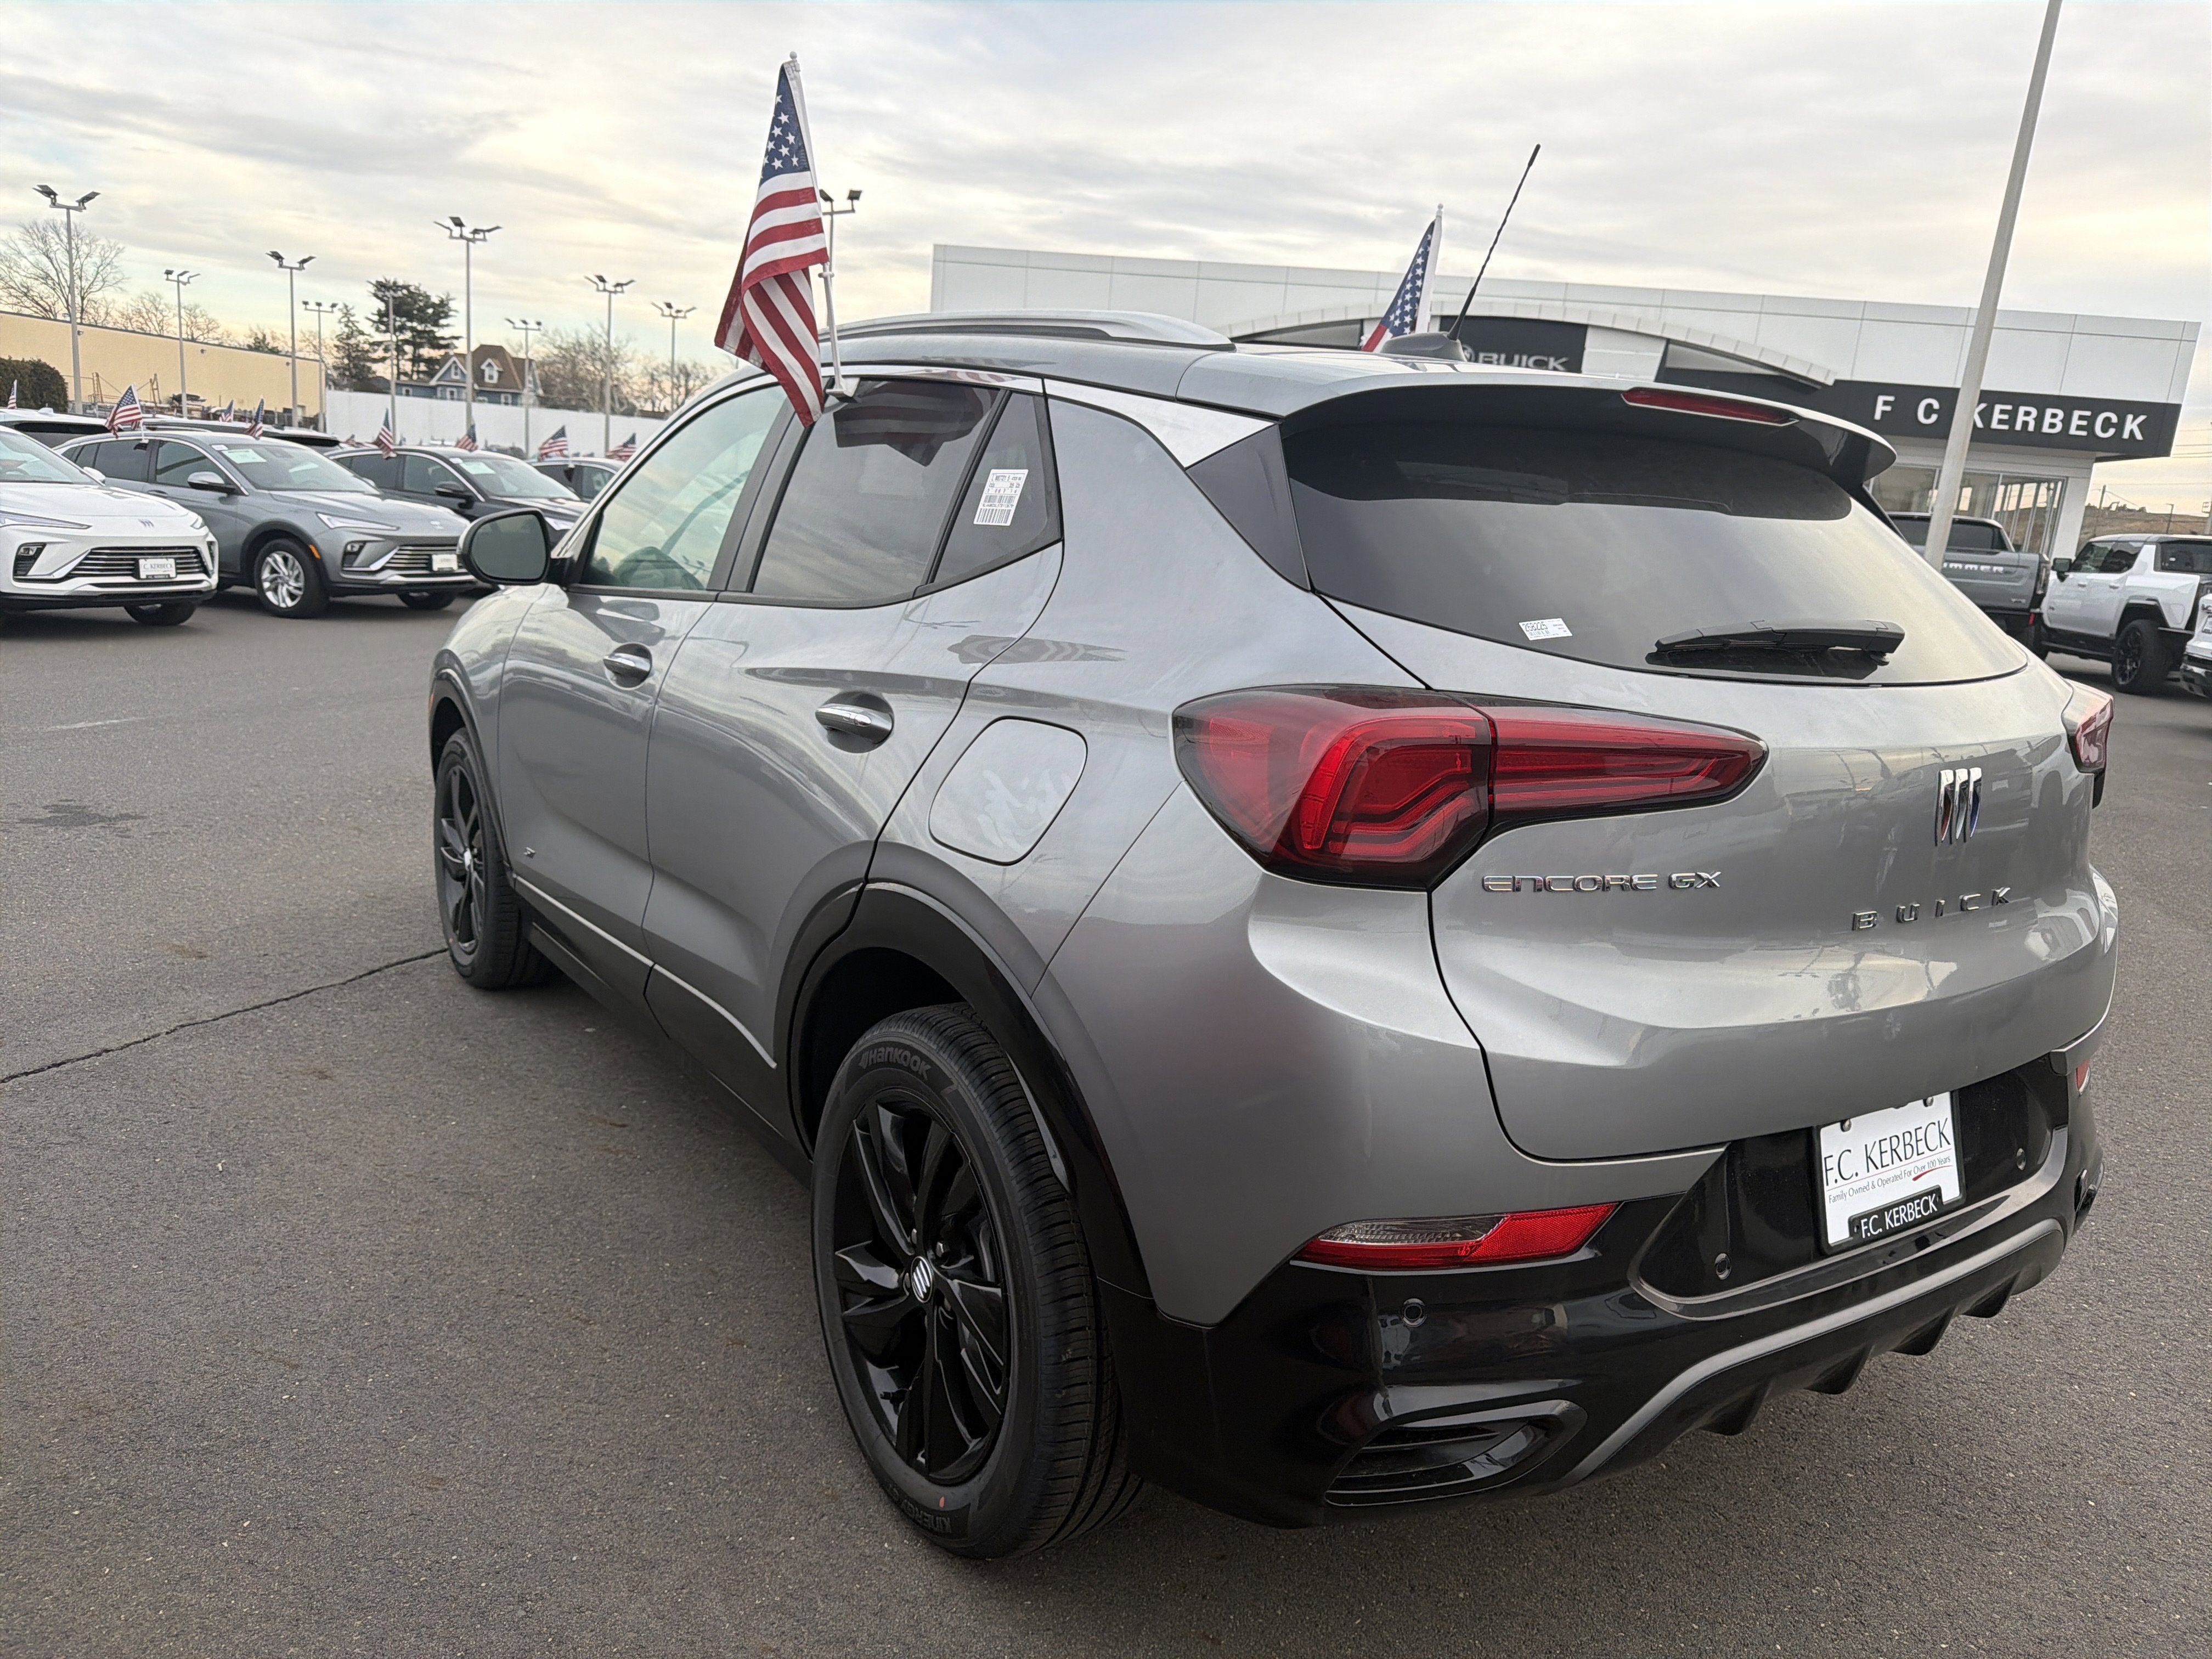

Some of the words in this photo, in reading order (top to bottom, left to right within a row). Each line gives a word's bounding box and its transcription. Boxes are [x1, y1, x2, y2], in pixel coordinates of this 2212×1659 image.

[1479, 352, 1569, 371] BUICK
[1874, 395, 1895, 420] F
[1917, 398, 1940, 425] C
[1973, 403, 2147, 441] KERBECK
[1482, 874, 1658, 892] ENCORE
[1668, 871, 1721, 889] GX
[1852, 887, 2011, 931] BUICK
[1824, 1149, 1859, 1187] F.C.
[1864, 1117, 1951, 1173] KERBECK
[1829, 1190, 1848, 1205] Family
[1848, 1182, 1870, 1197] Owned
[1871, 1180, 1876, 1189] &
[1877, 1170, 1903, 1188] Operated
[1904, 1169, 1913, 1179] For
[1913, 1165, 1926, 1175] Over
[1927, 1159, 1937, 1169] 100
[1937, 1156, 1951, 1166] Years
[1861, 1215, 1883, 1239] F.C.
[1884, 1193, 1938, 1231] KERBECK
